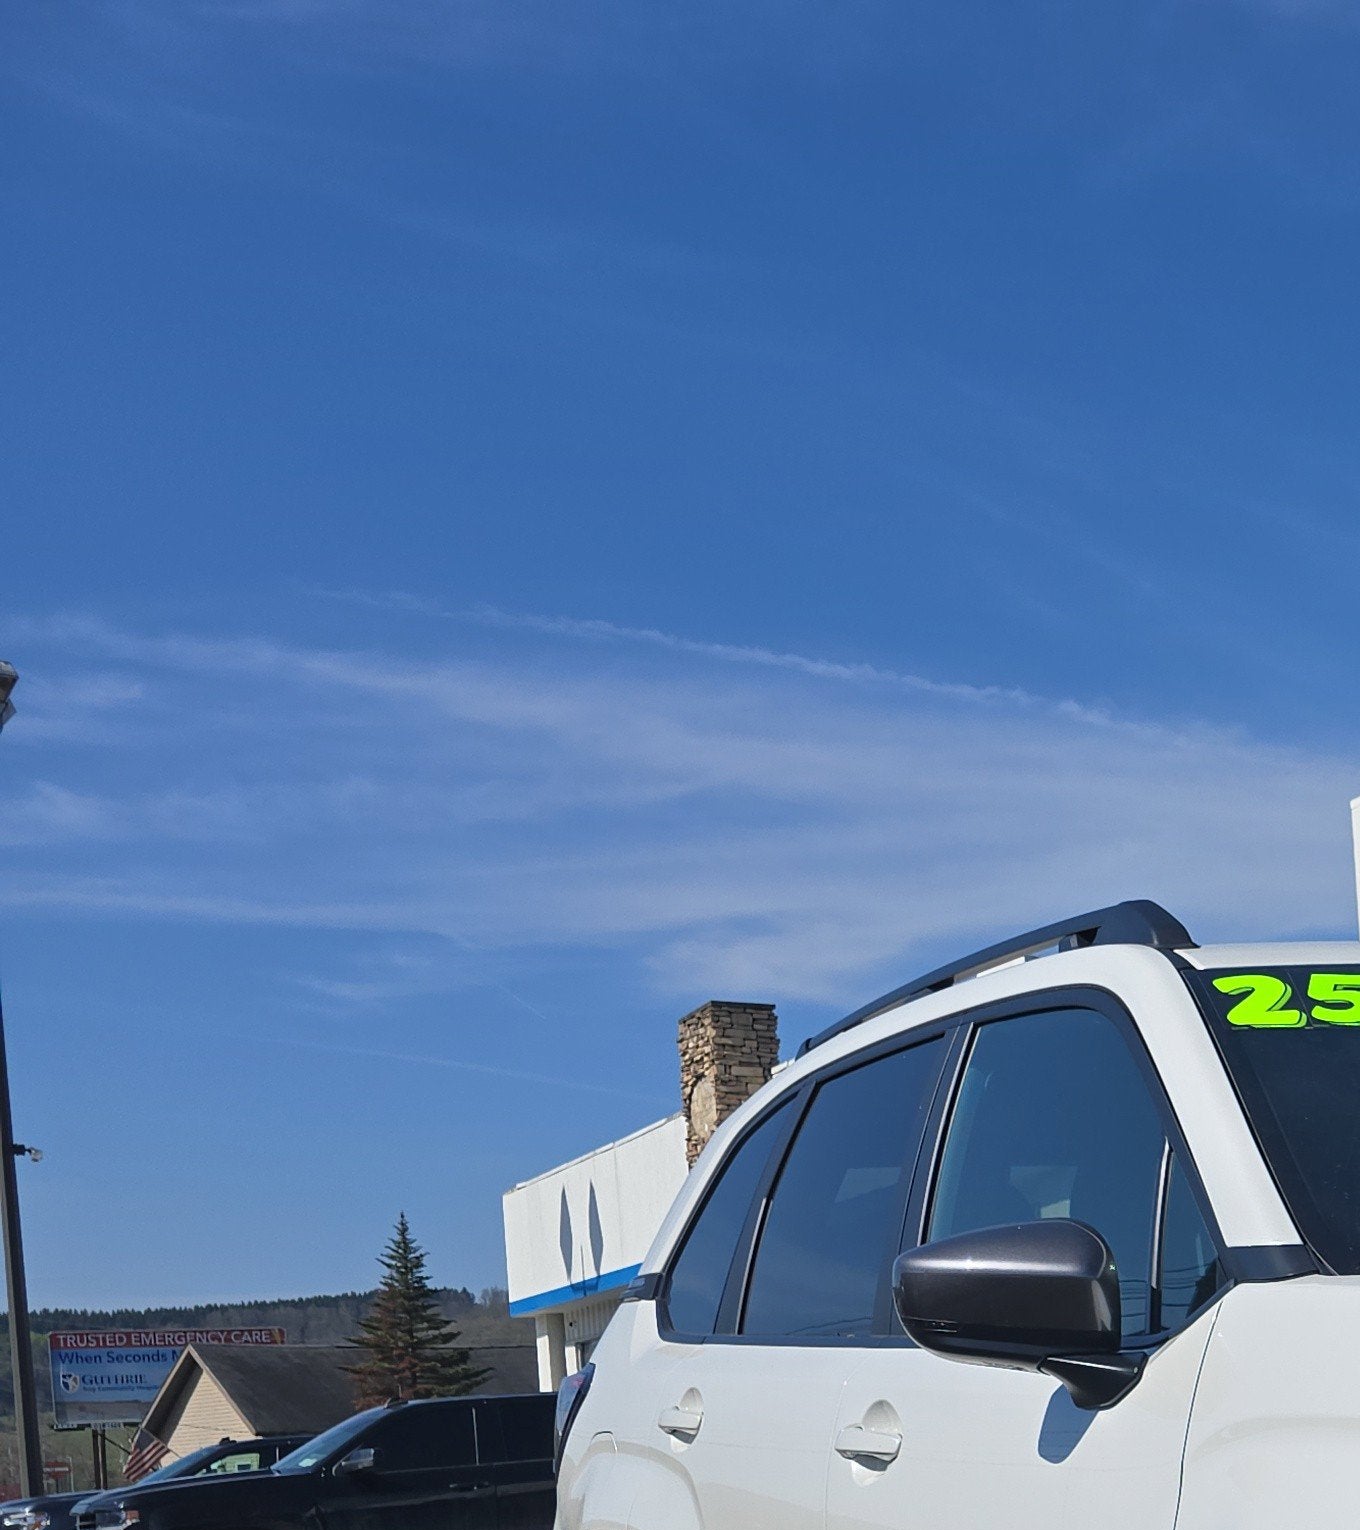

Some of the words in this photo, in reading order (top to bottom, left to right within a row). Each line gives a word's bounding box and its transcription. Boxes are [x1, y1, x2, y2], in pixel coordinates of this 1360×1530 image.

[58, 1332, 126, 1347] TRUSTED
[131, 1331, 227, 1346] EMERGENCY
[231, 1330, 272, 1344] CARE
[58, 1351, 101, 1365] When
[106, 1350, 168, 1364] Seconds
